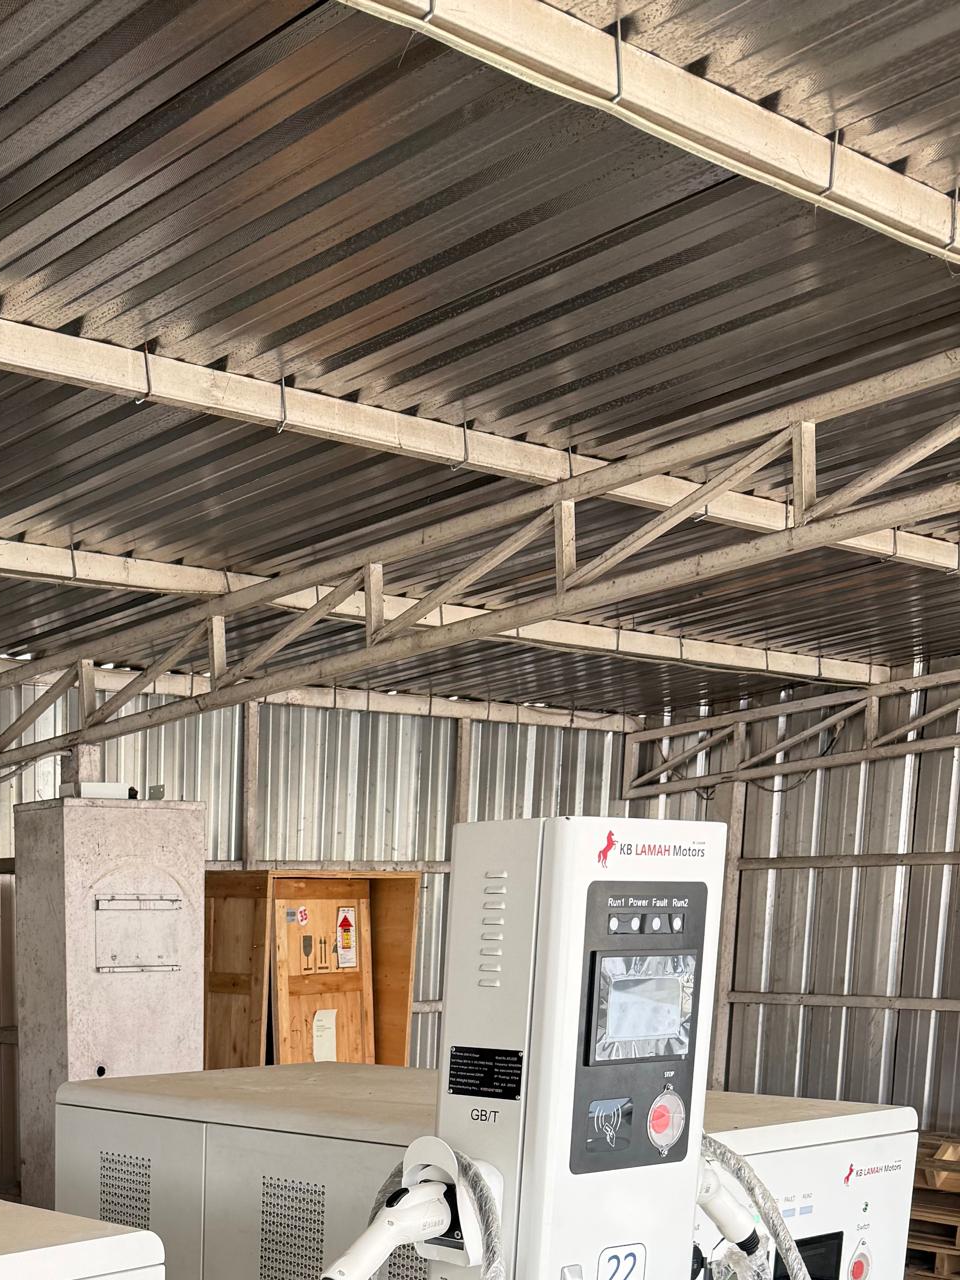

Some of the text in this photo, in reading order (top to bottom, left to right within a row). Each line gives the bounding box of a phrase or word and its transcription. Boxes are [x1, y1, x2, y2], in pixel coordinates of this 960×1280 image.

[619, 844, 705, 858] KB LAMAH Motors
[608, 898, 689, 908] Run1 Power Fault Run2
[470, 1108, 500, 1123] GB/T
